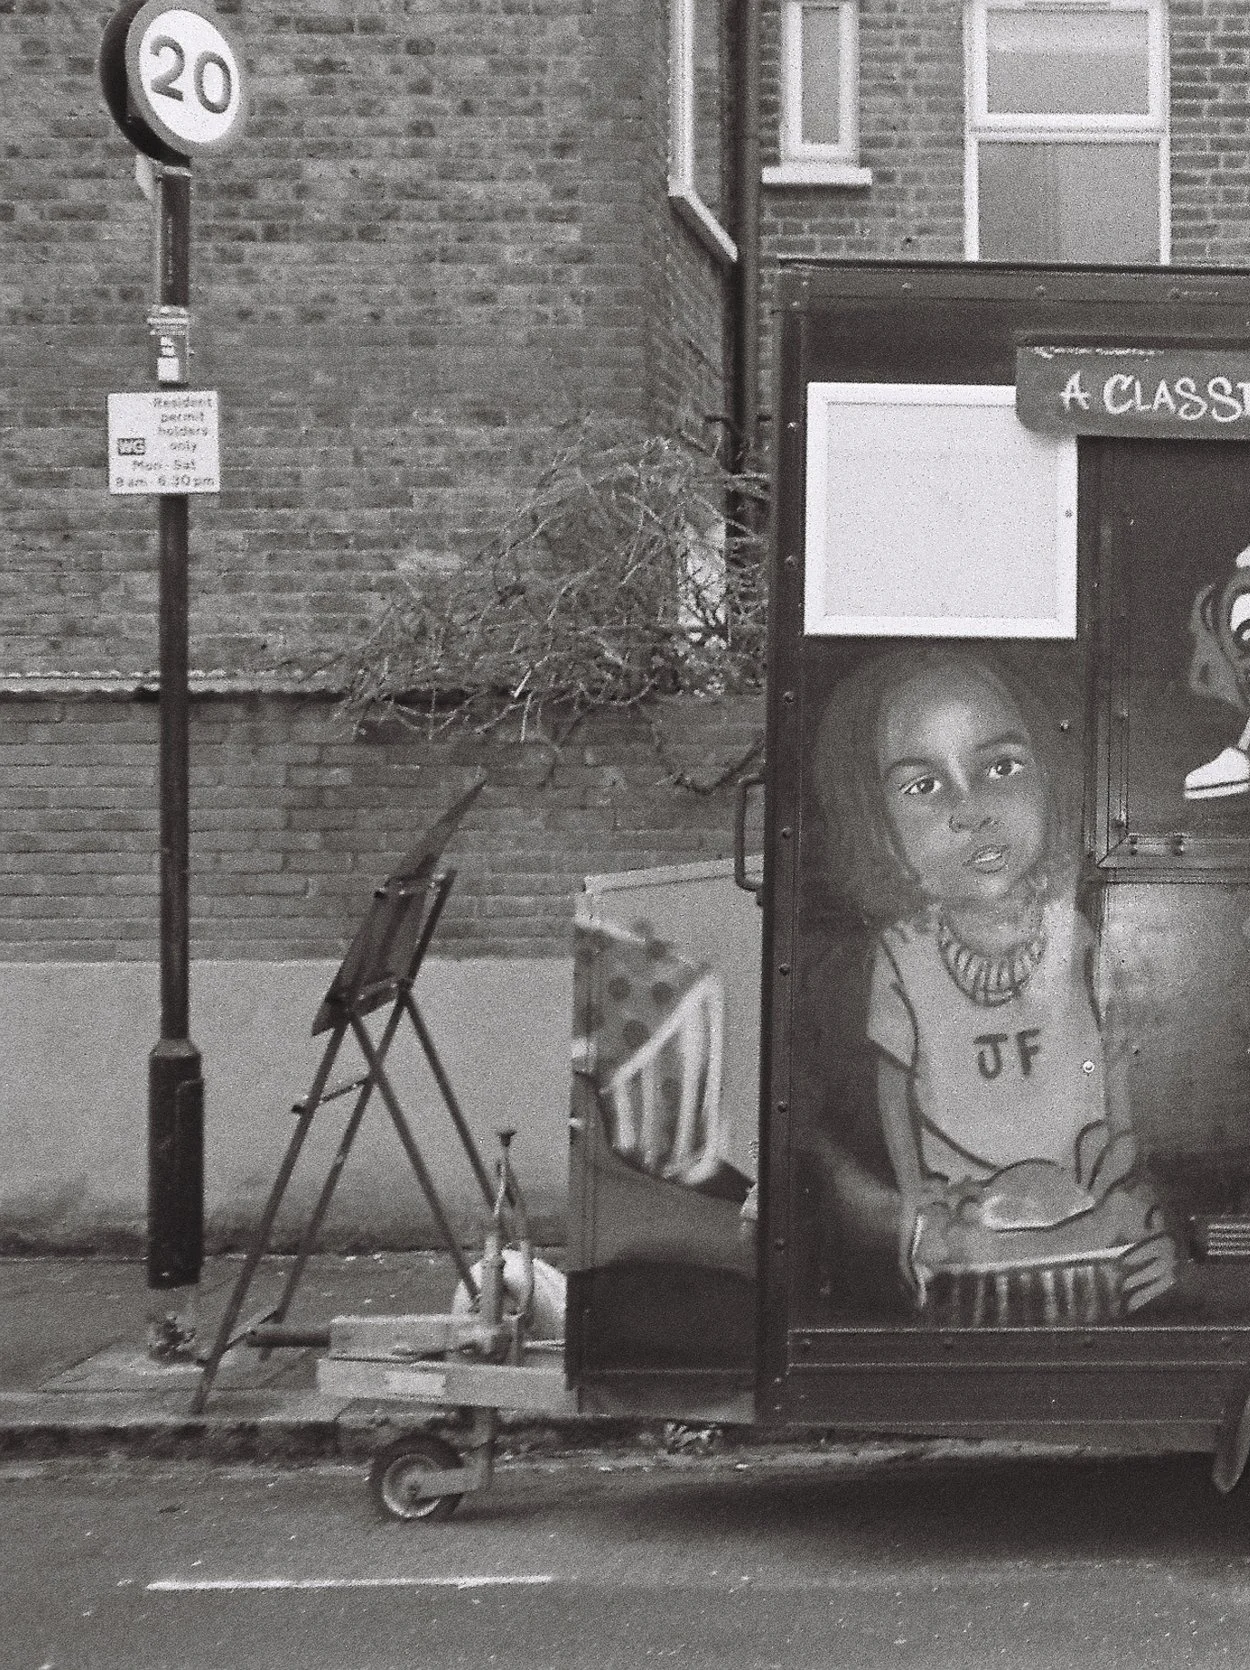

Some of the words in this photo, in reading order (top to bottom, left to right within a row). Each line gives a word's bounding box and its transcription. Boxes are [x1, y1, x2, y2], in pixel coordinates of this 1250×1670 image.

[149, 34, 232, 114] 20
[1060, 371, 1091, 411] A
[973, 1028, 1041, 1081] JF
